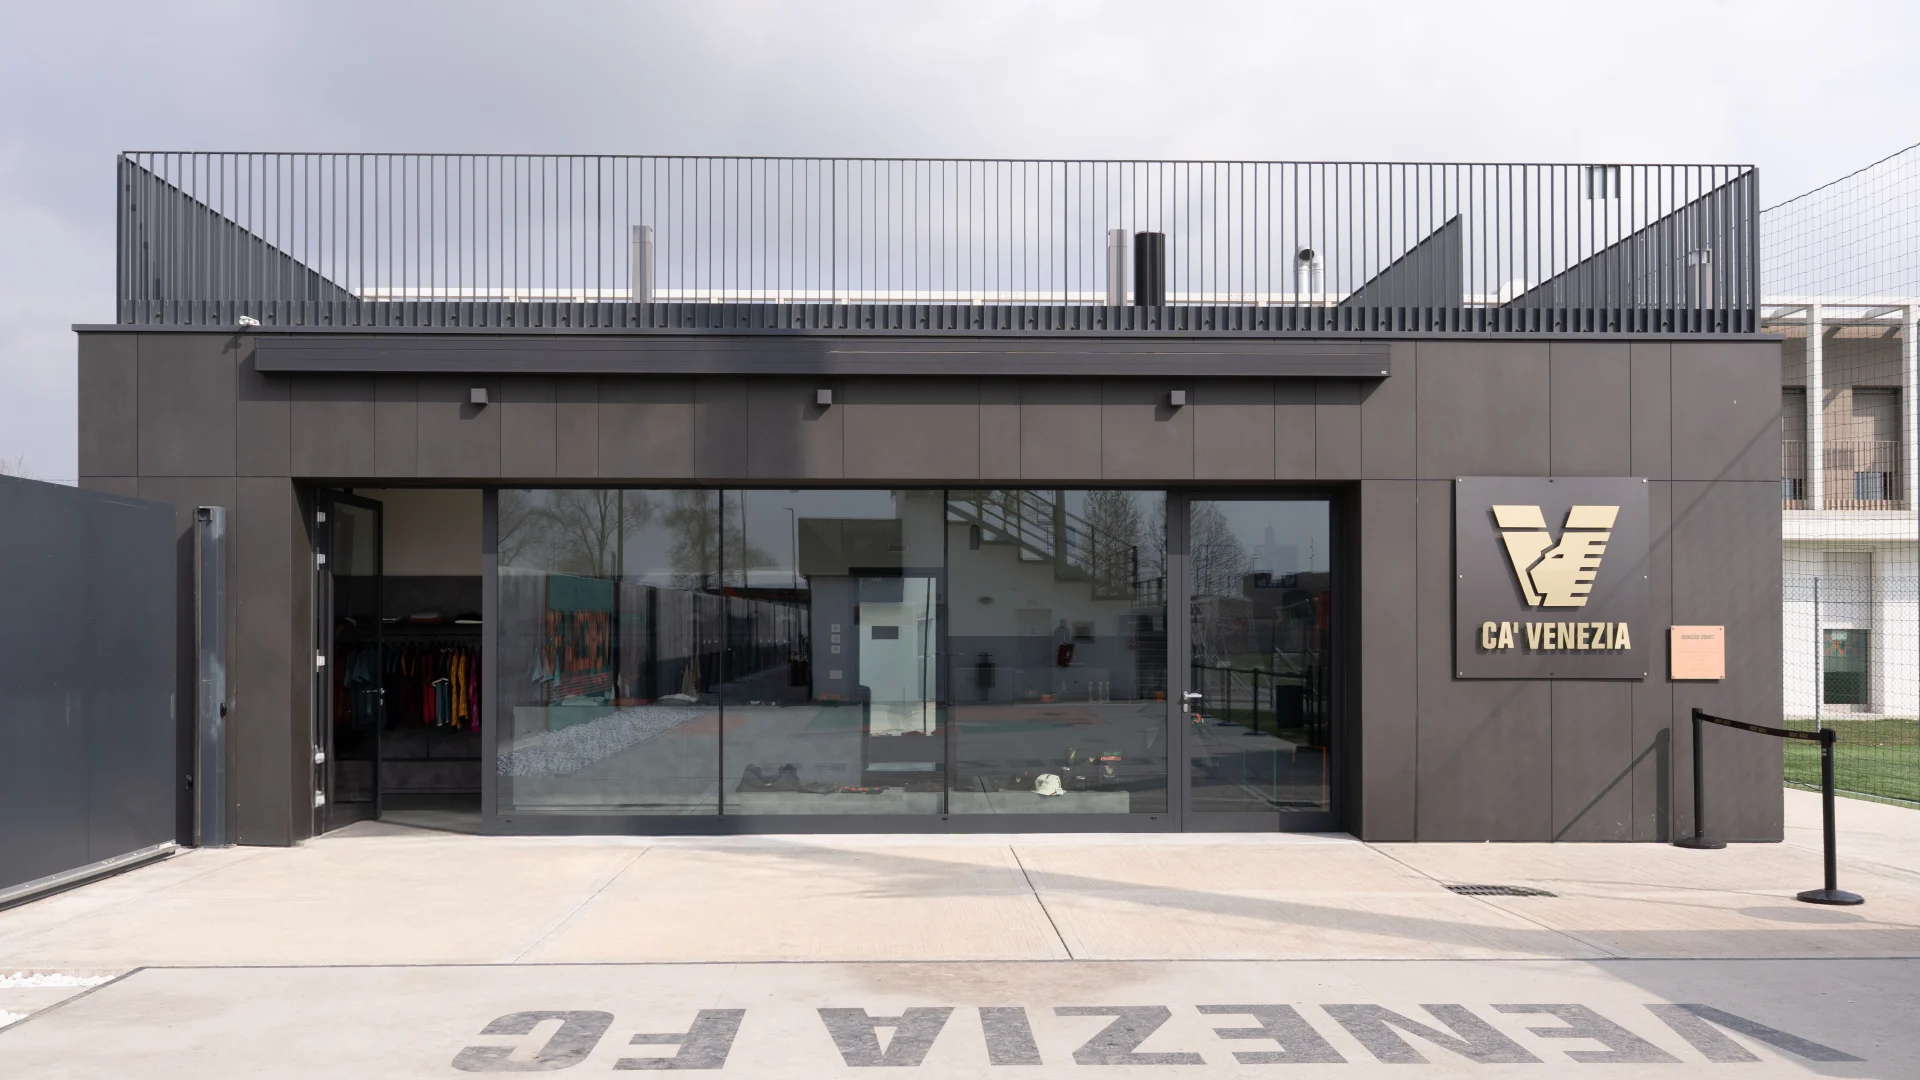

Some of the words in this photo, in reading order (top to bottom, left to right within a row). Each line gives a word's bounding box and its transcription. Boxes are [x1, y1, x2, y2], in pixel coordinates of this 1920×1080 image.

[1482, 621, 1519, 650] CA'
[1526, 622, 1631, 650] VENEZIA
[450, 1008, 747, 1072] FC
[816, 1003, 1867, 1067] VENEZIA
